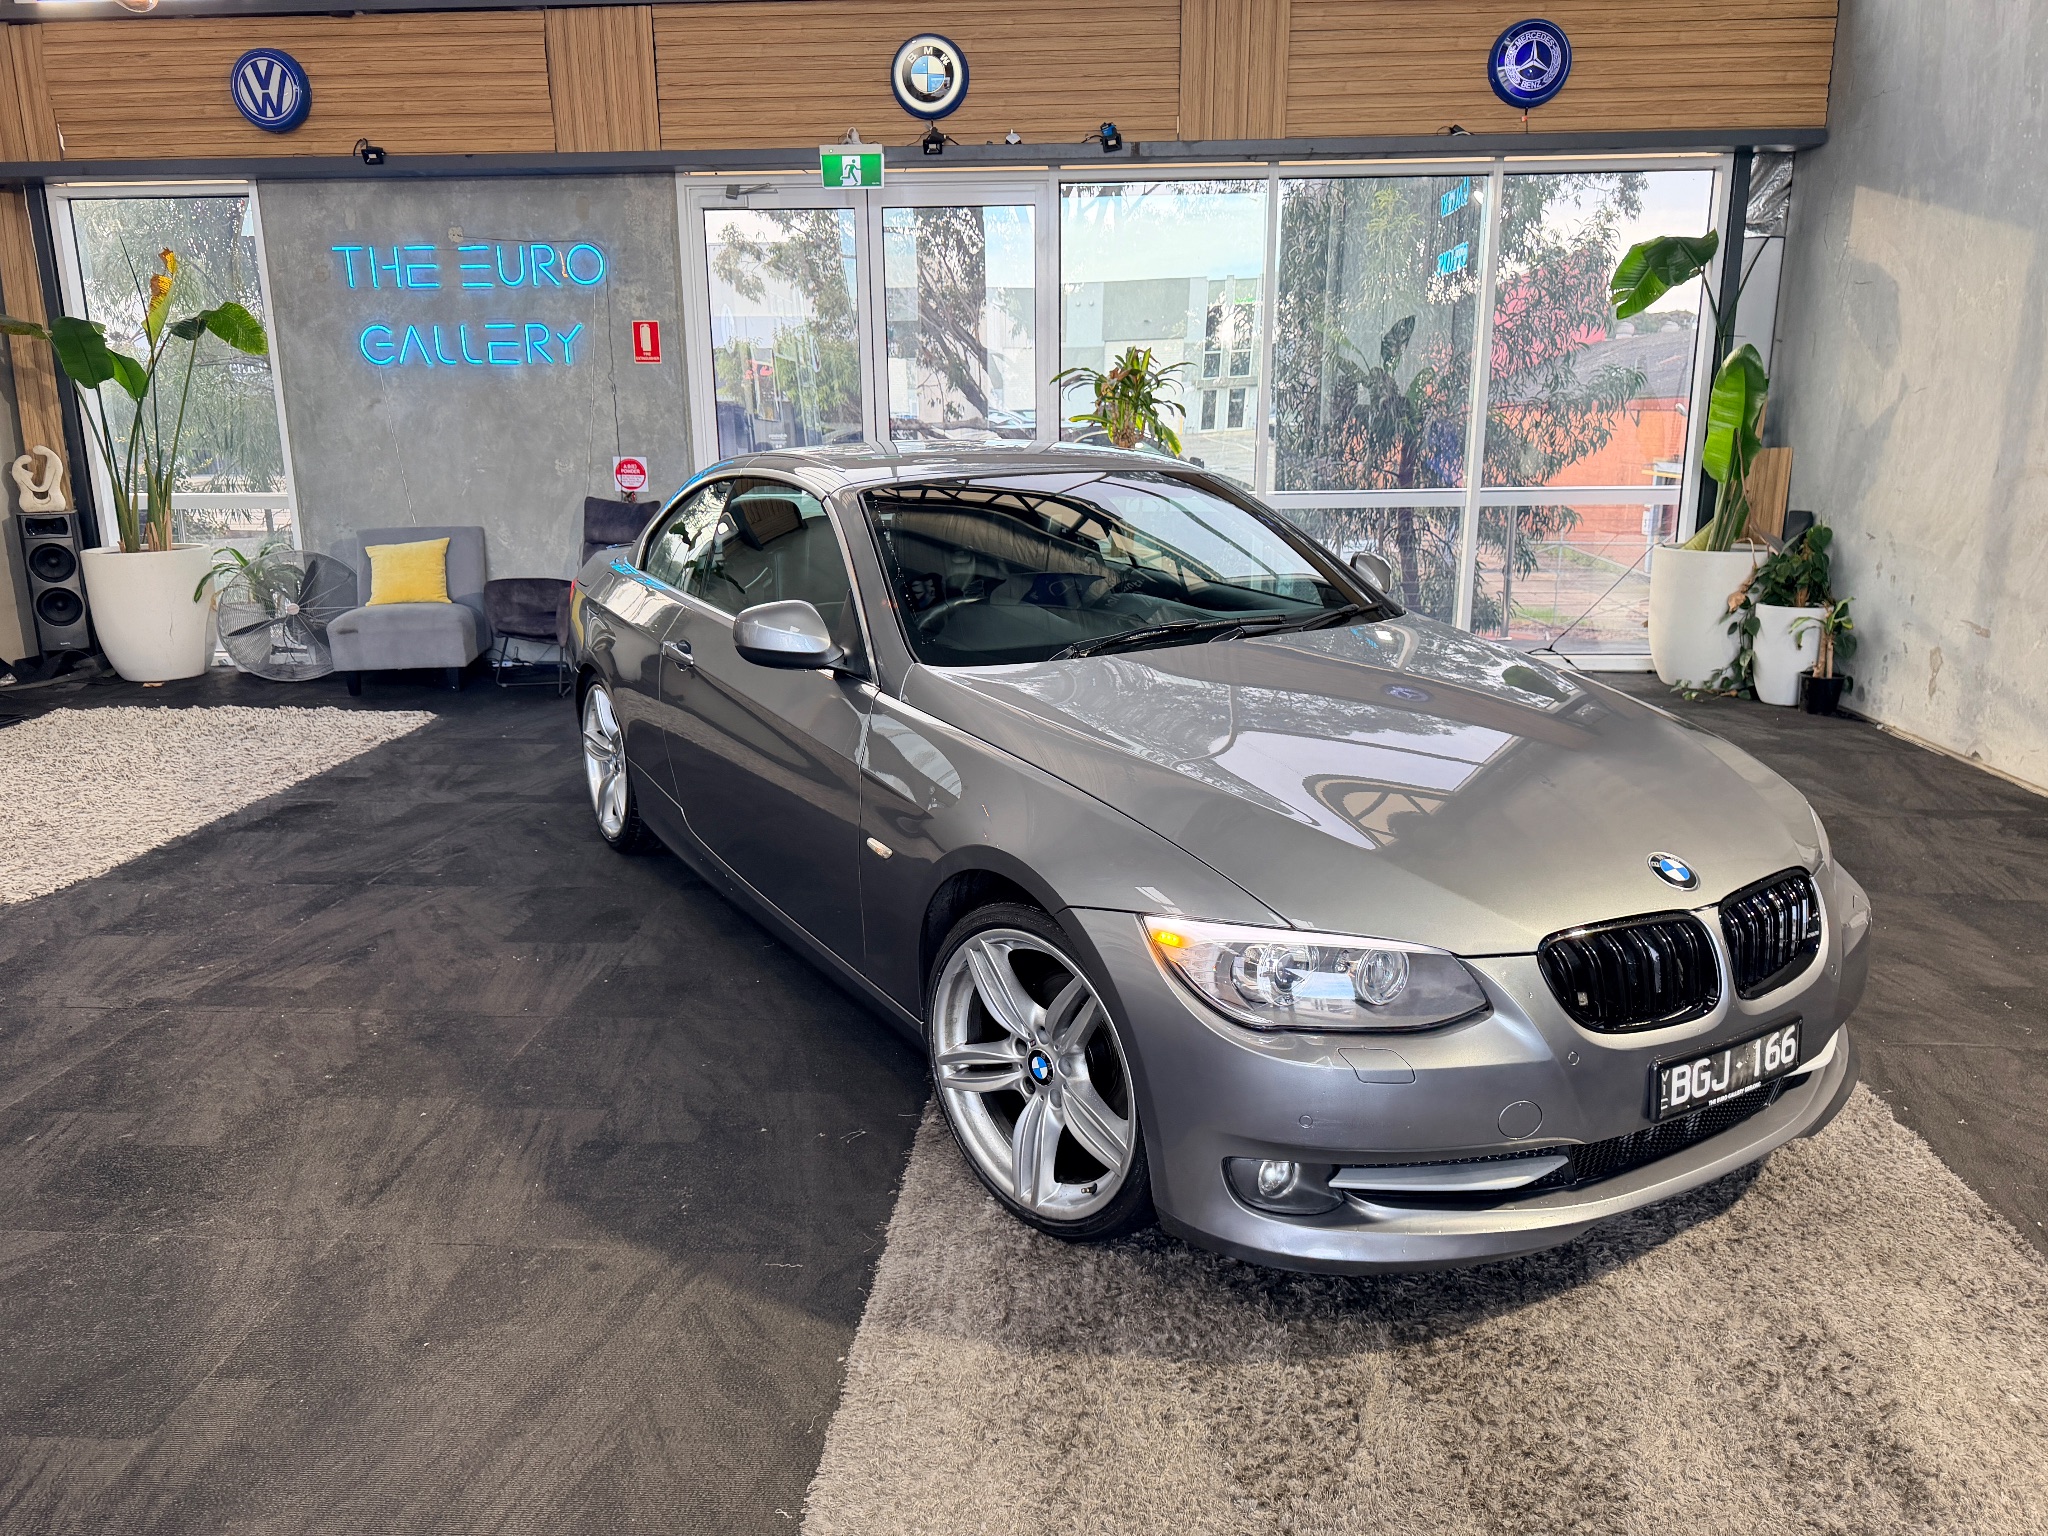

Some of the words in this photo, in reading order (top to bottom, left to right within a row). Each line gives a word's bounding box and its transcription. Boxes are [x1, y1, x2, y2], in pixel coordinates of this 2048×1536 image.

[907, 46, 951, 66] BMW
[1514, 32, 1555, 48] MERCEDES
[240, 59, 288, 118] VW
[1520, 80, 1542, 90] BENZ
[332, 245, 440, 288] THE
[458, 243, 605, 288] EURO
[360, 323, 583, 366] GALLERY
[1670, 1050, 1731, 1106] BGJ
[1753, 1024, 1796, 1077] 166
